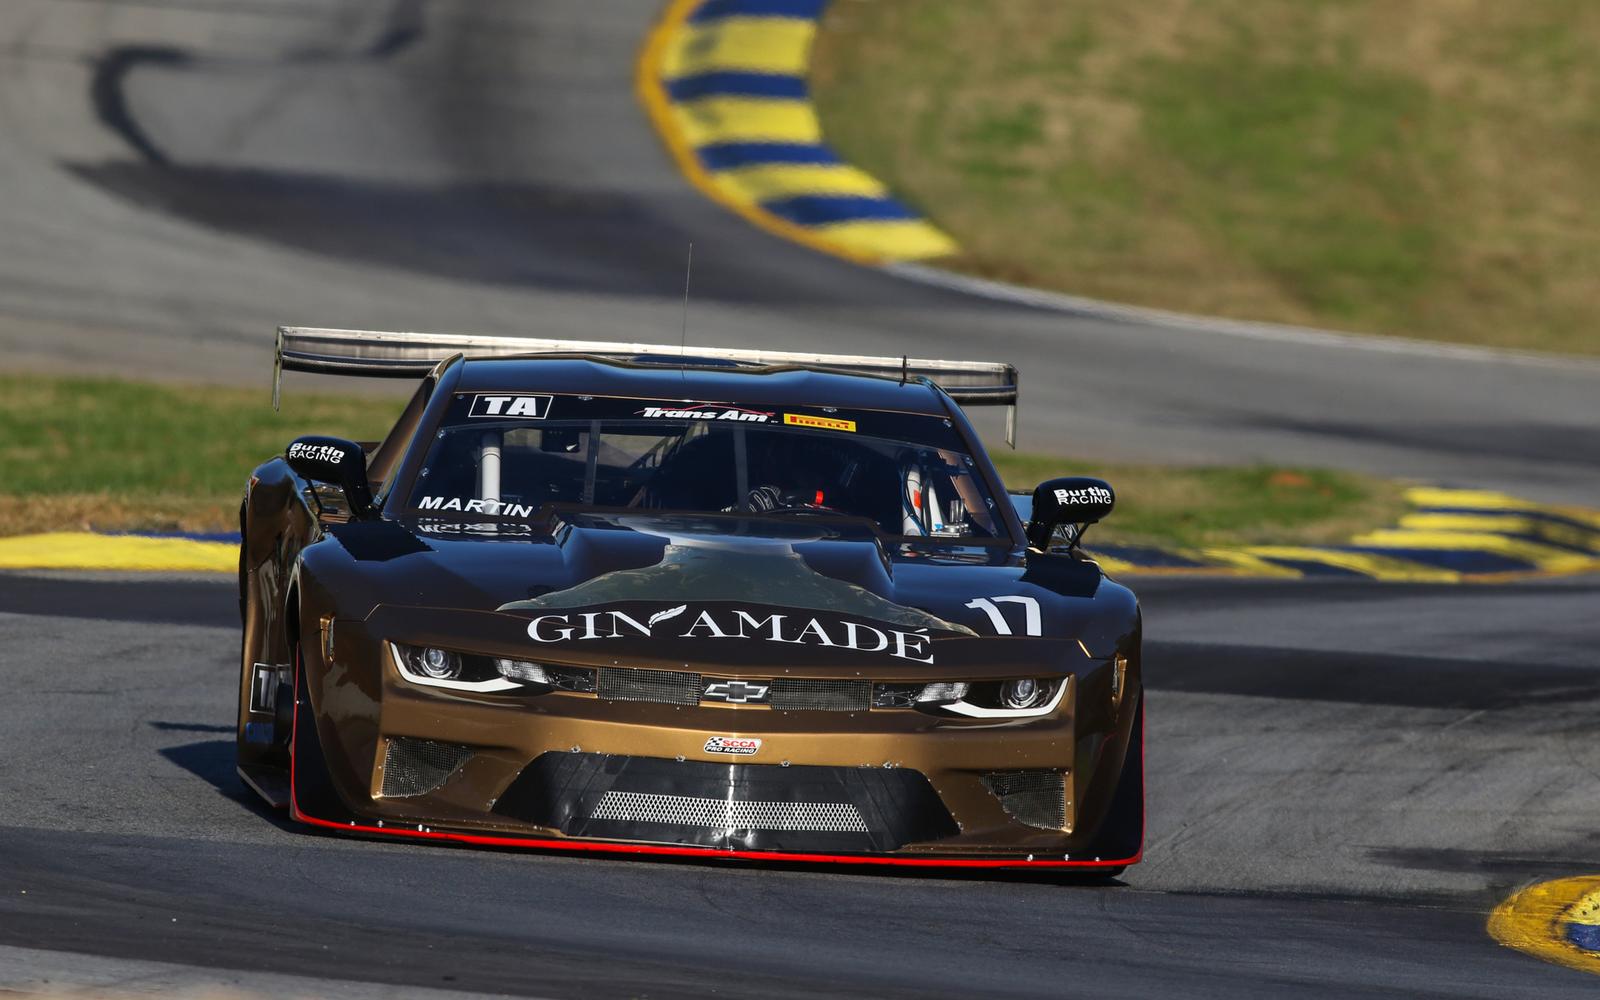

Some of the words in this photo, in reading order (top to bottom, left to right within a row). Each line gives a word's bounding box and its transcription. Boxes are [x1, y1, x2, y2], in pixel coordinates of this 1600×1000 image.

[484, 397, 537, 416] TA
[643, 407, 718, 420] Trans
[717, 410, 768, 423] Am
[289, 450, 341, 464] RACING
[290, 442, 345, 458] Burtin
[1053, 486, 1111, 498] Burtin
[1057, 495, 1112, 505] RACING
[418, 496, 533, 518] MARTIN
[965, 595, 1043, 637] 17
[527, 611, 653, 644] GIN
[679, 609, 935, 665] AMADÉ
[722, 740, 756, 748] SCCA
